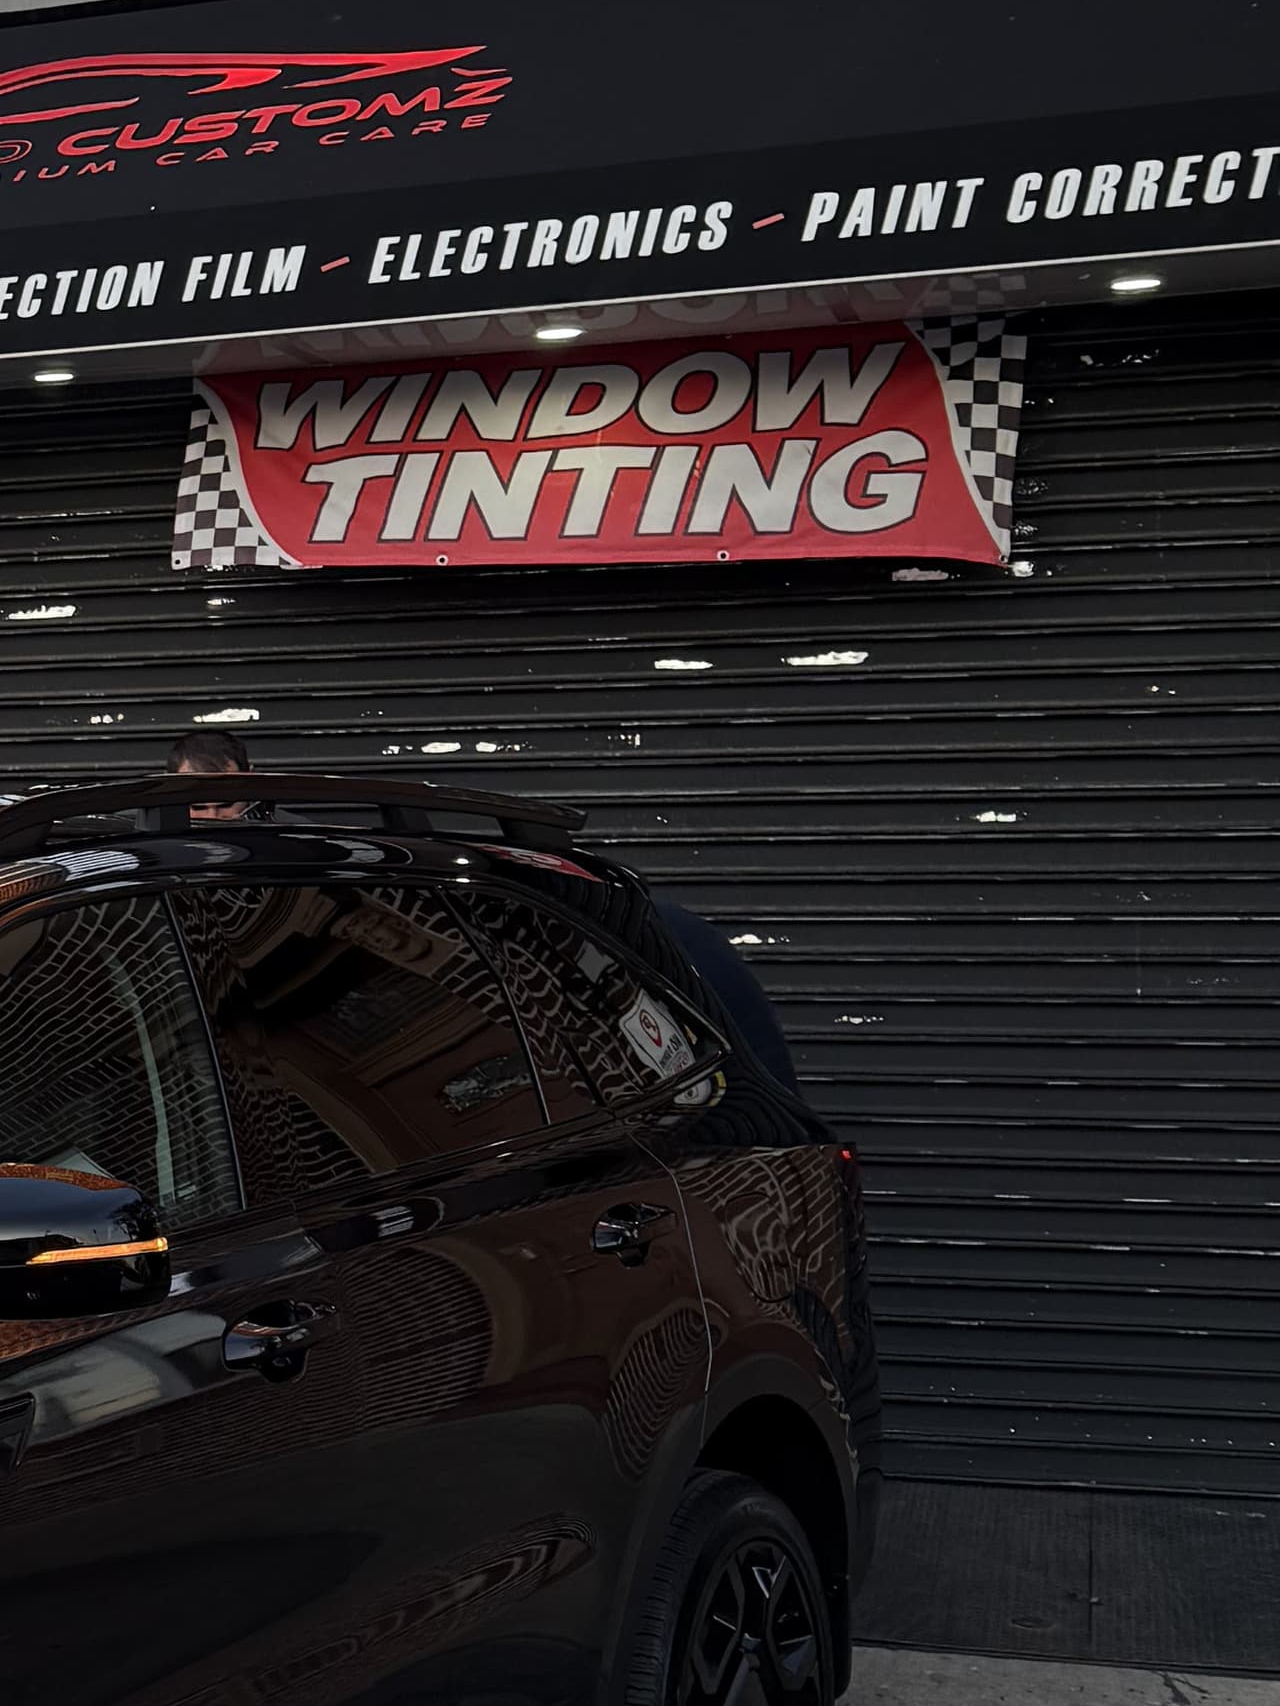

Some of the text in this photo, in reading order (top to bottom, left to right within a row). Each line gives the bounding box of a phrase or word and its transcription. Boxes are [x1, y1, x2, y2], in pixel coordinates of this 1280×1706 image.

[56, 75, 514, 157] CUSTOMZ
[155, 139, 280, 167] CAR
[318, 112, 492, 147] CARE
[181, 243, 307, 303] FILM
[368, 200, 733, 287] ELECTRONICS
[800, 176, 984, 242] PAINT
[255, 341, 906, 453] WINDOW
[302, 427, 930, 545] TINTING
